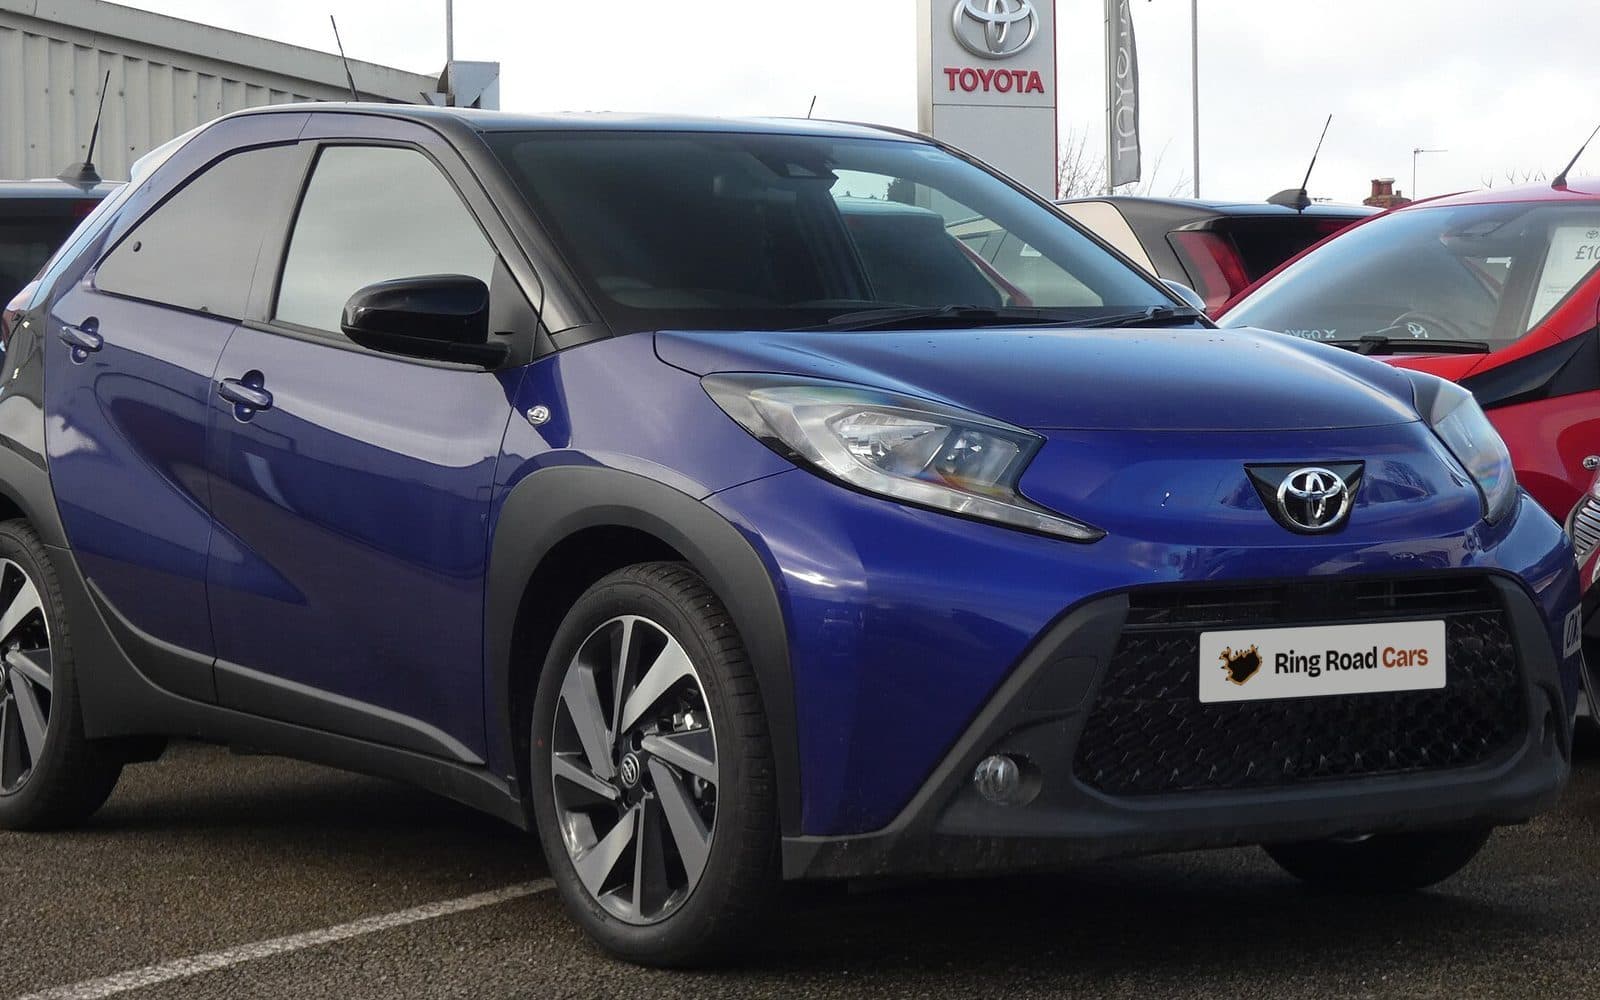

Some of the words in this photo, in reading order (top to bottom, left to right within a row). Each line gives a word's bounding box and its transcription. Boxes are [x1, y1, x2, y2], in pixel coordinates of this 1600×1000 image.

[943, 67, 1045, 94] TOYOTA
[1324, 329, 1337, 339] X
[1274, 650, 1321, 677] Ring
[1325, 646, 1378, 671] Road
[1382, 646, 1429, 669] Cars
